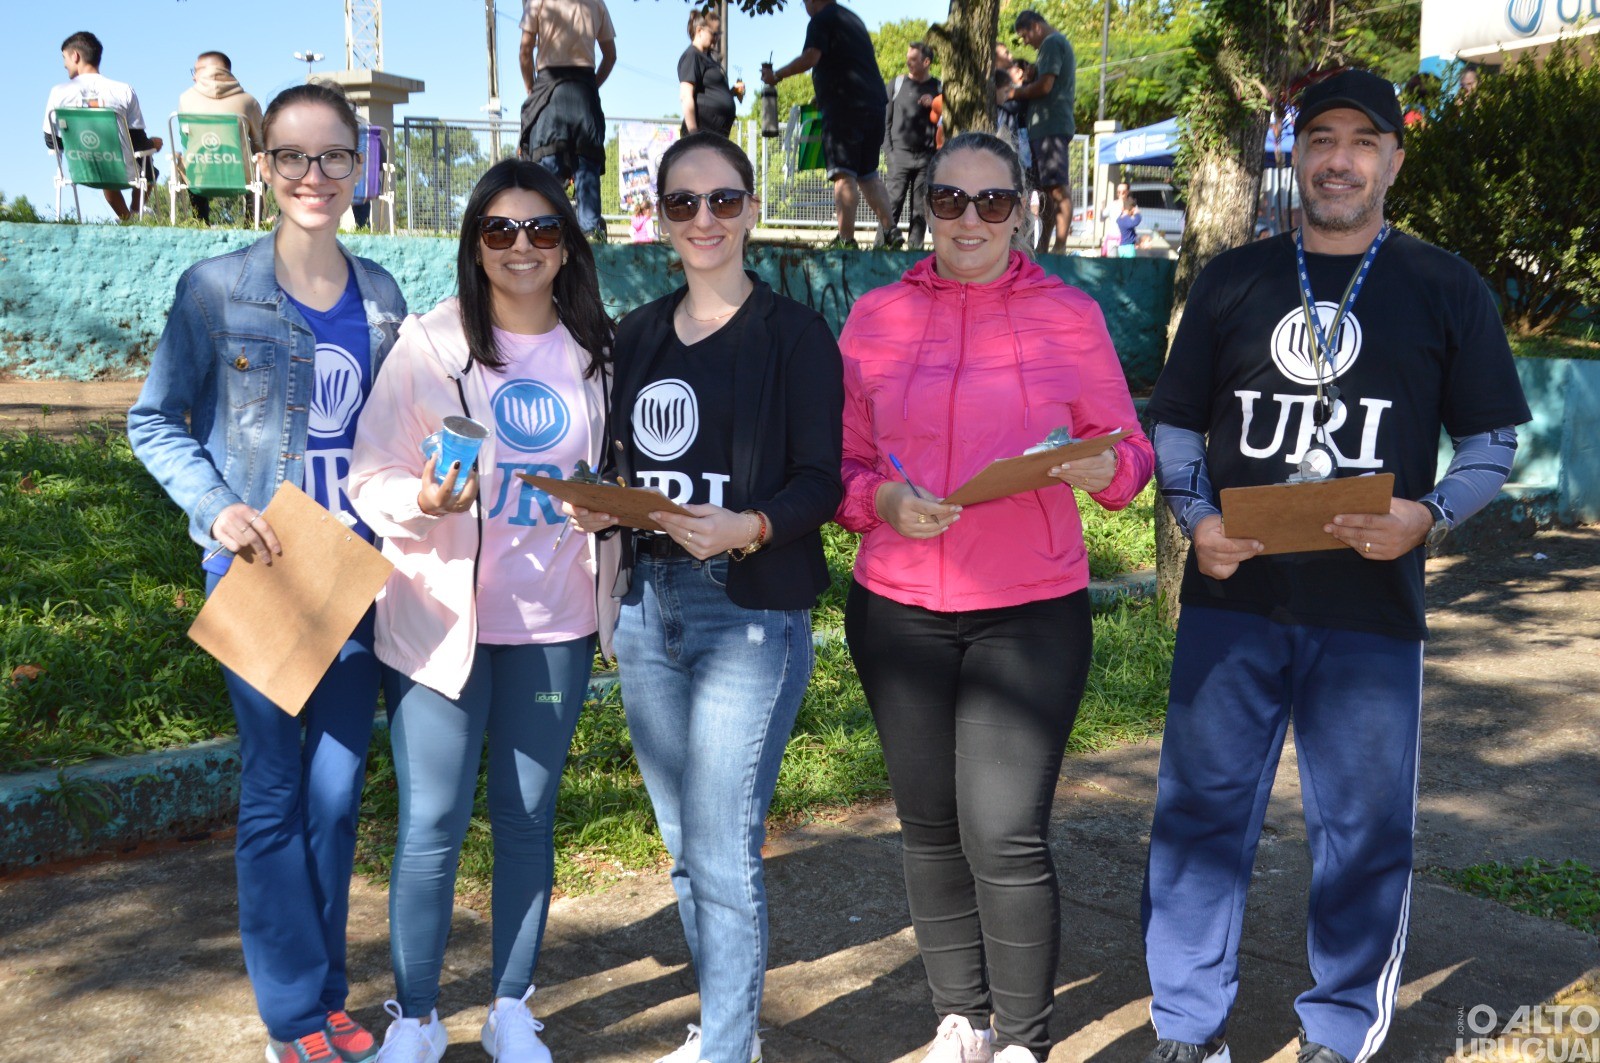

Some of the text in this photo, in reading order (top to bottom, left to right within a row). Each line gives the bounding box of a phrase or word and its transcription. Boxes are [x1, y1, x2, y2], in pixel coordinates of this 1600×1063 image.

[67, 151, 122, 163] CRESOL
[186, 153, 241, 164] CRESOL
[1234, 390, 1393, 468] URI
